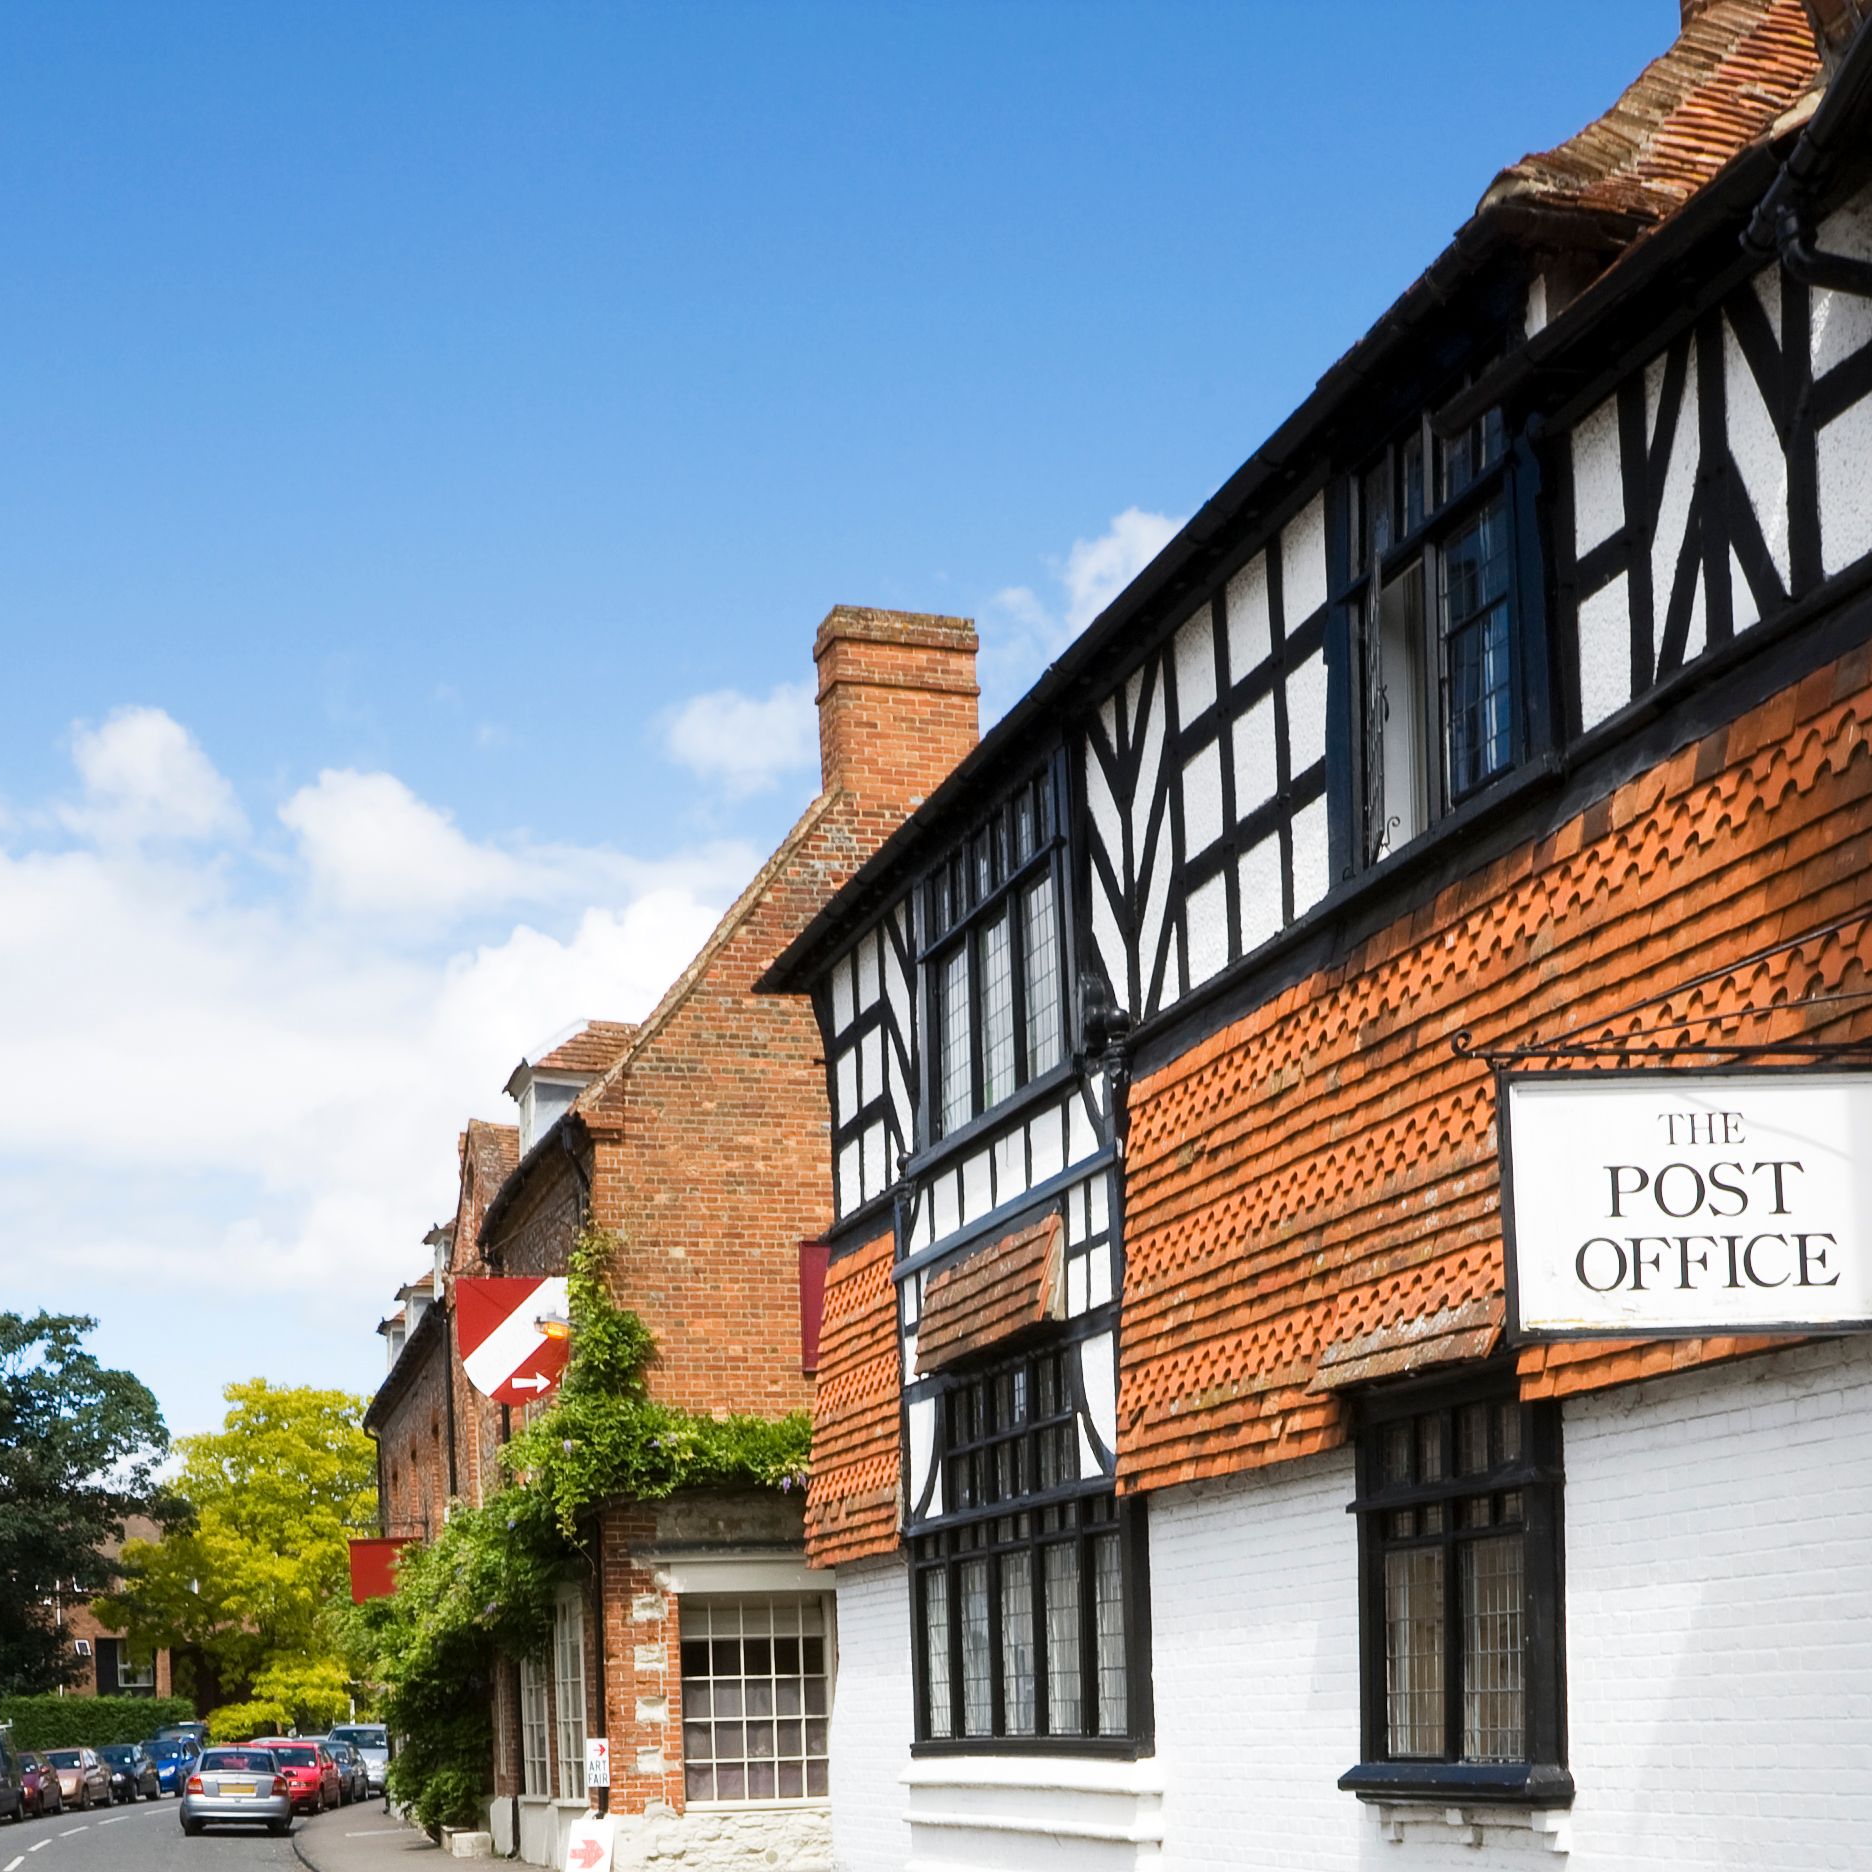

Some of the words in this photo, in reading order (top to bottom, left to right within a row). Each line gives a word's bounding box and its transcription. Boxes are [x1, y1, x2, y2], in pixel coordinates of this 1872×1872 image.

[1657, 1112, 1746, 1145] THE
[1603, 1161, 1805, 1218] POST
[1575, 1233, 1841, 1292] OFFICE
[588, 1773, 608, 1784] FAIR
[589, 1760, 607, 1771] ART
